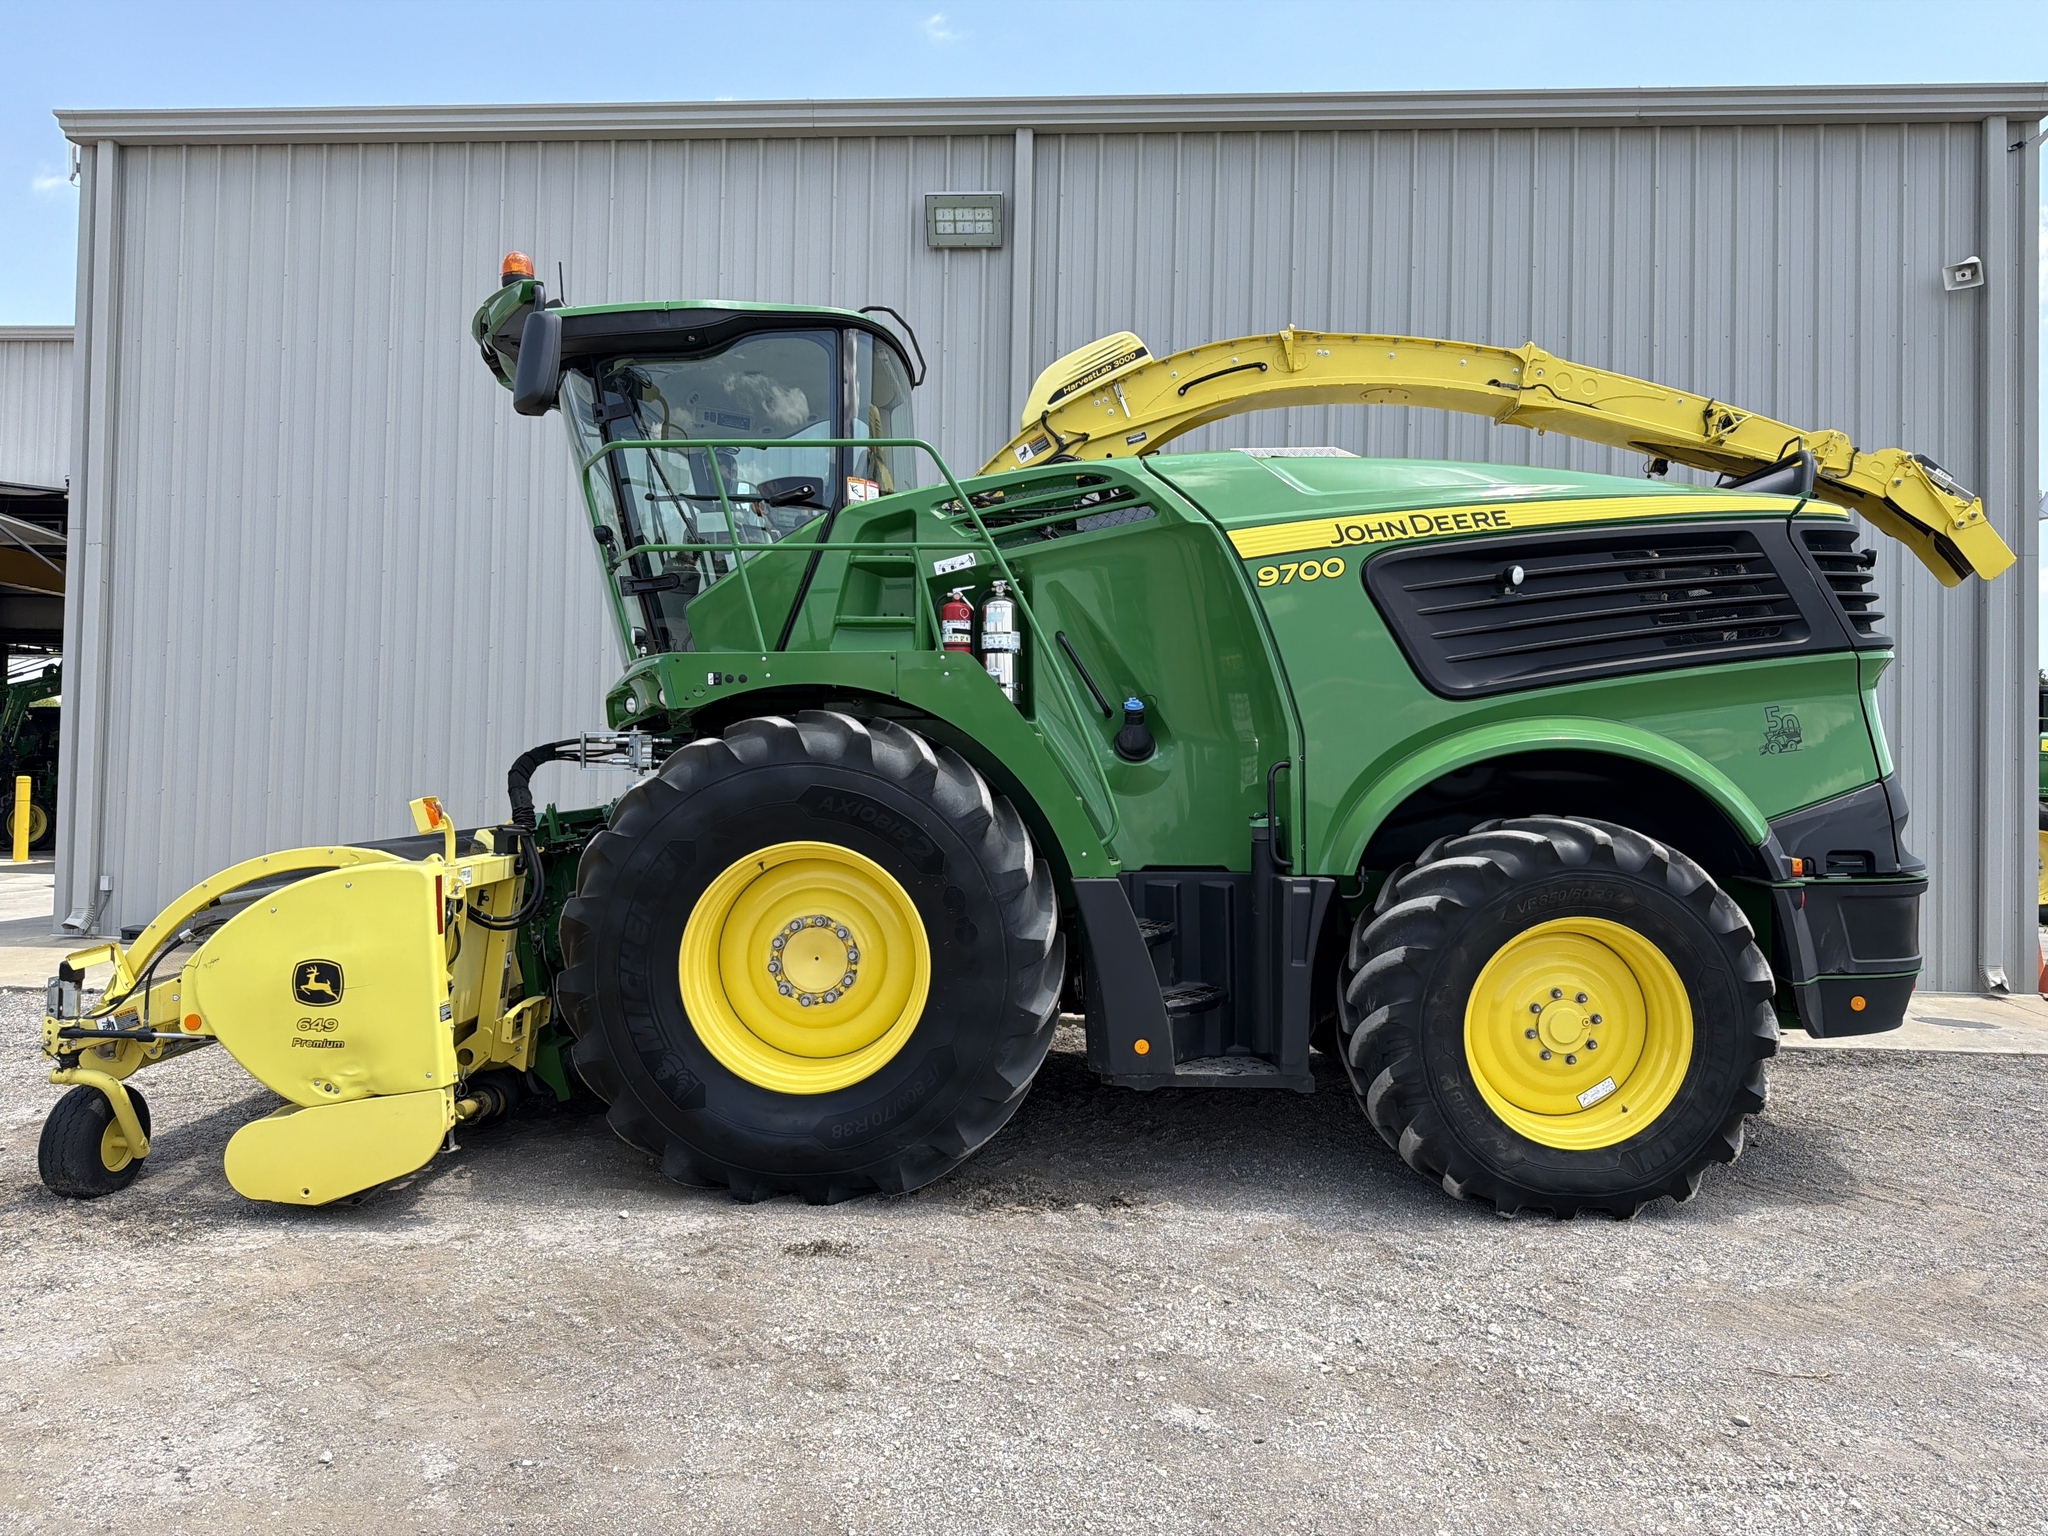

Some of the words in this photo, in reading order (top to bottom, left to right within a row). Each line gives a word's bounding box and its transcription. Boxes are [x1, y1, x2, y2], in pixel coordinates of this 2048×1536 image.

[1063, 364, 1112, 395] HarvestLab
[1113, 352, 1137, 368] 3000
[1331, 519, 1408, 544] JOHN
[1408, 510, 1511, 535] DEERE
[1257, 556, 1346, 587] 9700
[818, 796, 913, 842] AXIOBIB
[901, 836, 935, 864] 2
[296, 1017, 339, 1032] 649
[291, 1037, 345, 1049] Premium
